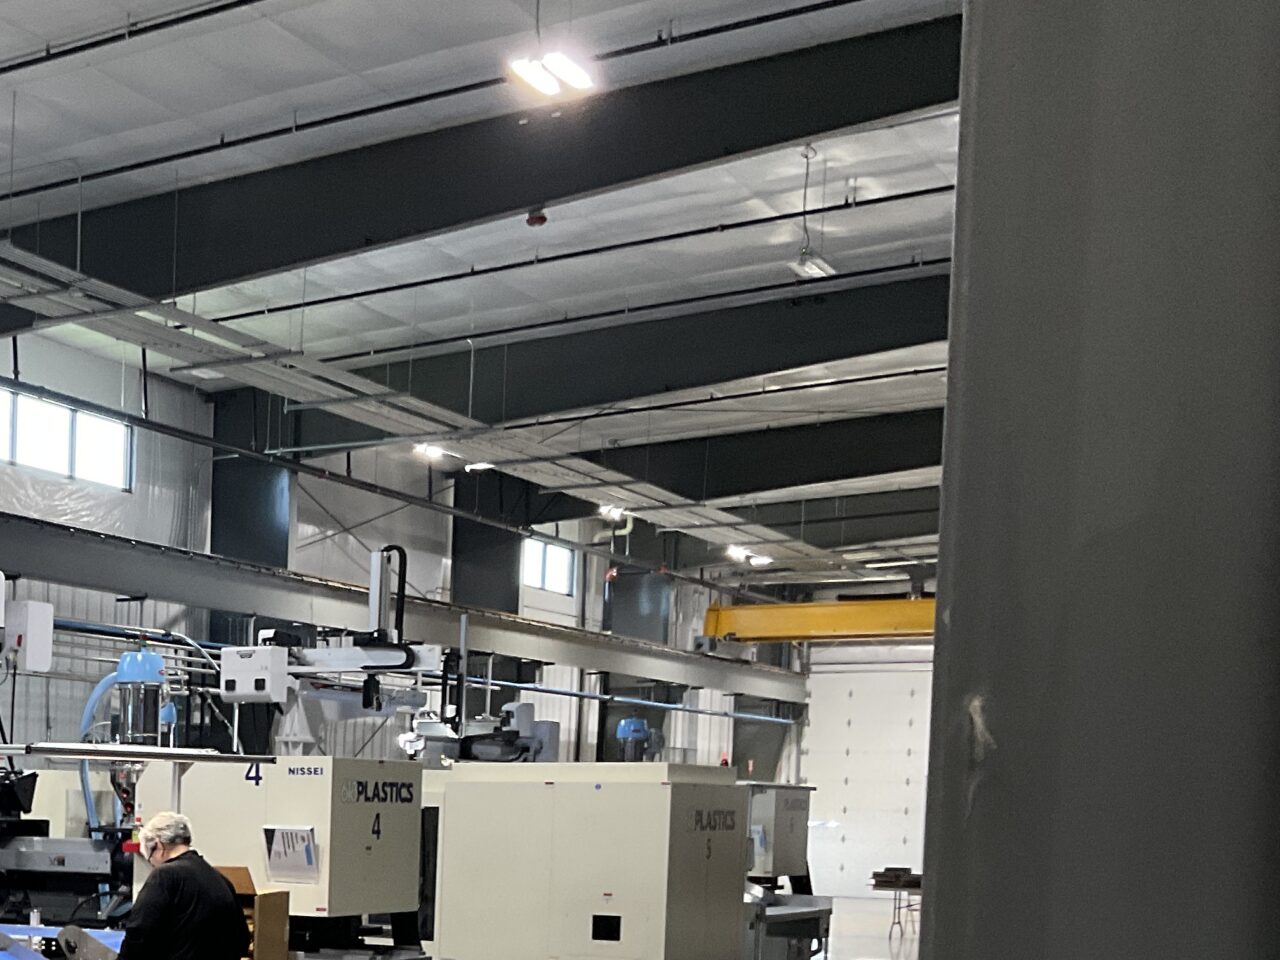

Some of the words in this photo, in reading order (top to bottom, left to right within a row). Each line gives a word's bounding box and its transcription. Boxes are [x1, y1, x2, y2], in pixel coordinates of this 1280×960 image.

[245, 762, 262, 786] 4
[288, 767, 324, 775] NISSEI
[372, 812, 381, 840] 4
